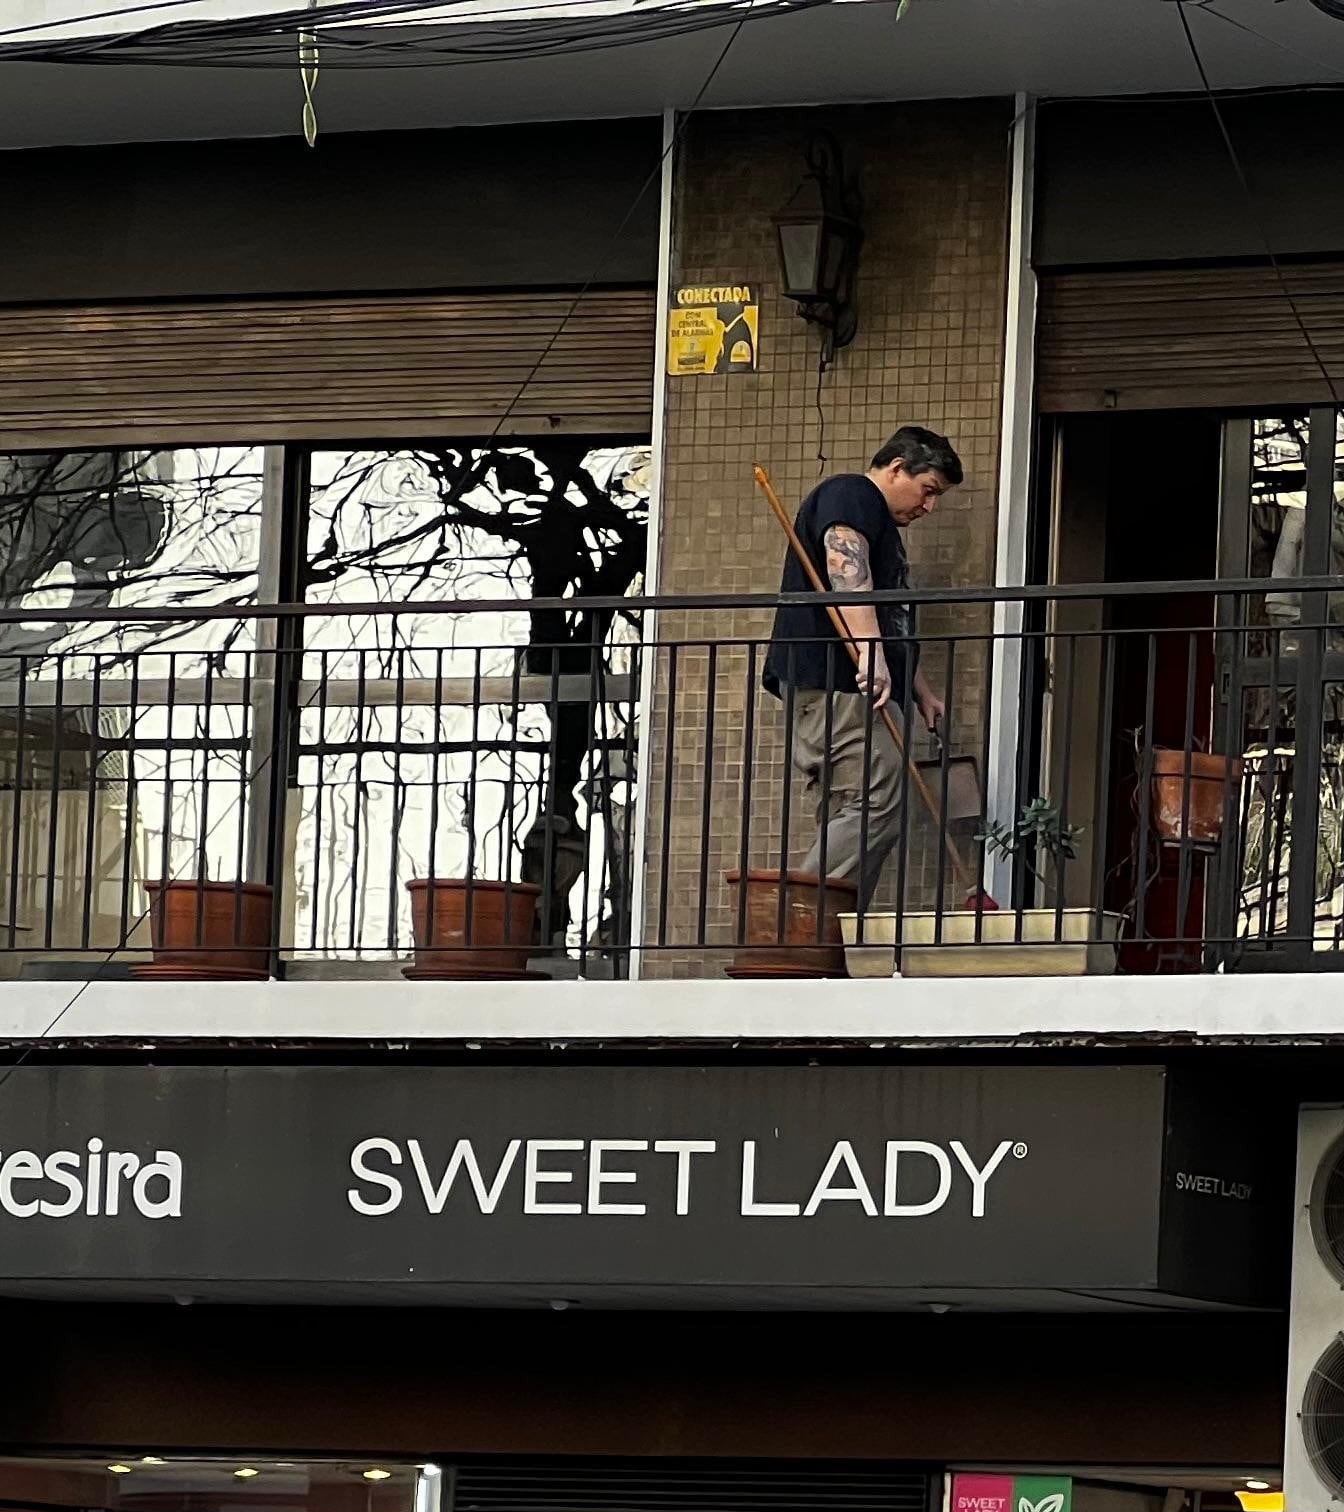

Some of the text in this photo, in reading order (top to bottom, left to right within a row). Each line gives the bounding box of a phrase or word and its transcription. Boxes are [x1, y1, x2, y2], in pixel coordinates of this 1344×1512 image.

[677, 286, 751, 304] CONECTADA
[0, 1137, 183, 1219] esira
[347, 1137, 716, 1217] SWEET
[1175, 1171, 1253, 1200] SWEET LADY
[958, 1497, 1006, 1509] SWEET
